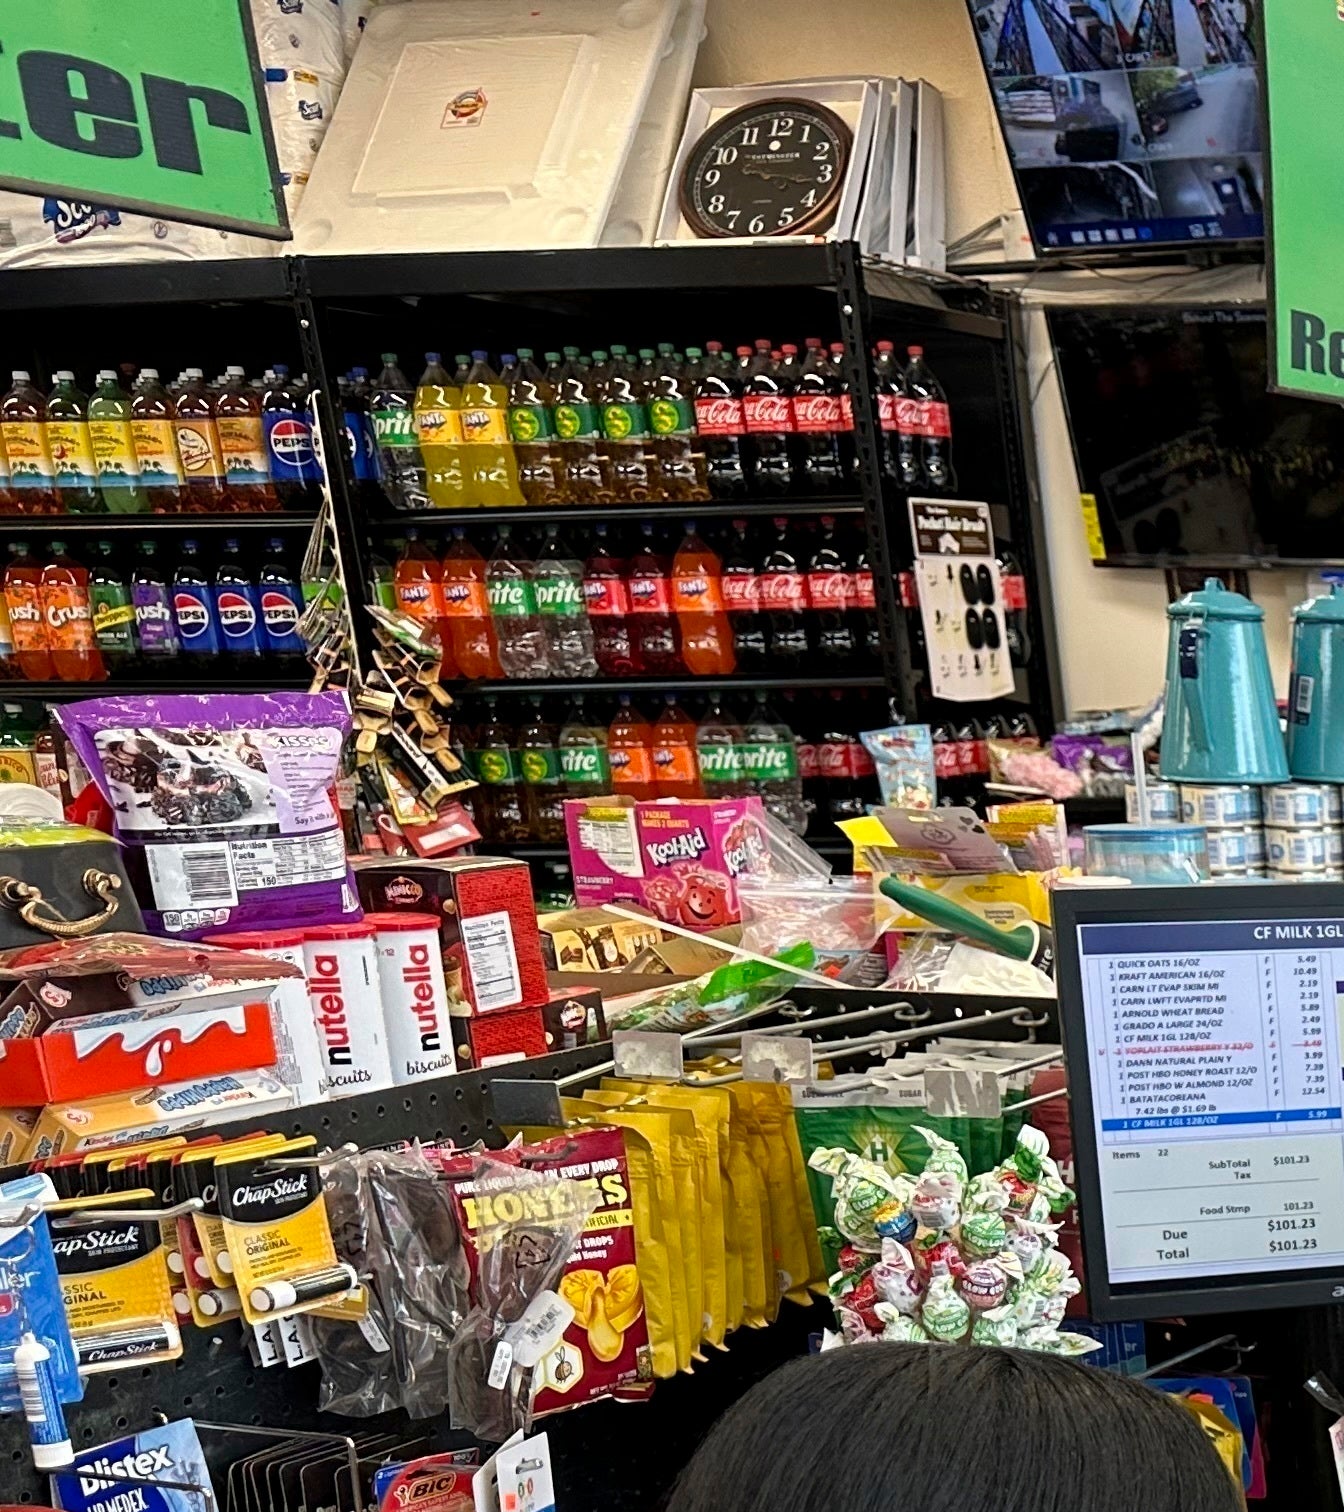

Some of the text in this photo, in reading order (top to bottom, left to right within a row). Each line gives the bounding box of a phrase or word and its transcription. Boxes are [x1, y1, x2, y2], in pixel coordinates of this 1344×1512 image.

[739, 127, 759, 146] 11
[767, 117, 794, 137] 12
[799, 124, 811, 143] 1
[713, 147, 738, 166] 10
[812, 142, 830, 161] 2
[704, 169, 720, 188] 9
[816, 164, 832, 183] 3
[708, 195, 725, 214] 8
[800, 189, 817, 208] 4
[725, 210, 741, 230] 7
[748, 214, 764, 234] 6
[778, 207, 794, 227] 5
[646, 826, 707, 866] Kool-Aid
[1254, 926, 1272, 939] CF
[1275, 926, 1312, 939] MILK
[1316, 925, 1344, 938] 1GL
[1148, 971, 1196, 980] AMERICAN
[404, 943, 441, 1052] nutella
[308, 954, 353, 1066] nutella
[406, 1054, 452, 1076] biscuits
[1112, 1149, 1168, 1160] Items 22
[1208, 1155, 1310, 1170] SubTotal $101.23
[560, 1158, 618, 1178] EVERY DROP
[1234, 1171, 1251, 1180] Tax
[232, 1173, 307, 1207] ChapStick
[1199, 1202, 1314, 1216] Food Stmp 101.23
[244, 1229, 281, 1245] CLASSIC
[1163, 1218, 1316, 1241] Due $101.23
[53, 1227, 139, 1255] apStick
[245, 1237, 291, 1256] ORIGINAL
[1156, 1239, 1317, 1261] Total $101.23
[88, 1342, 159, 1362] ChapStick
[77, 1445, 173, 1497] Blistex
[412, 1474, 453, 1500] BIC
